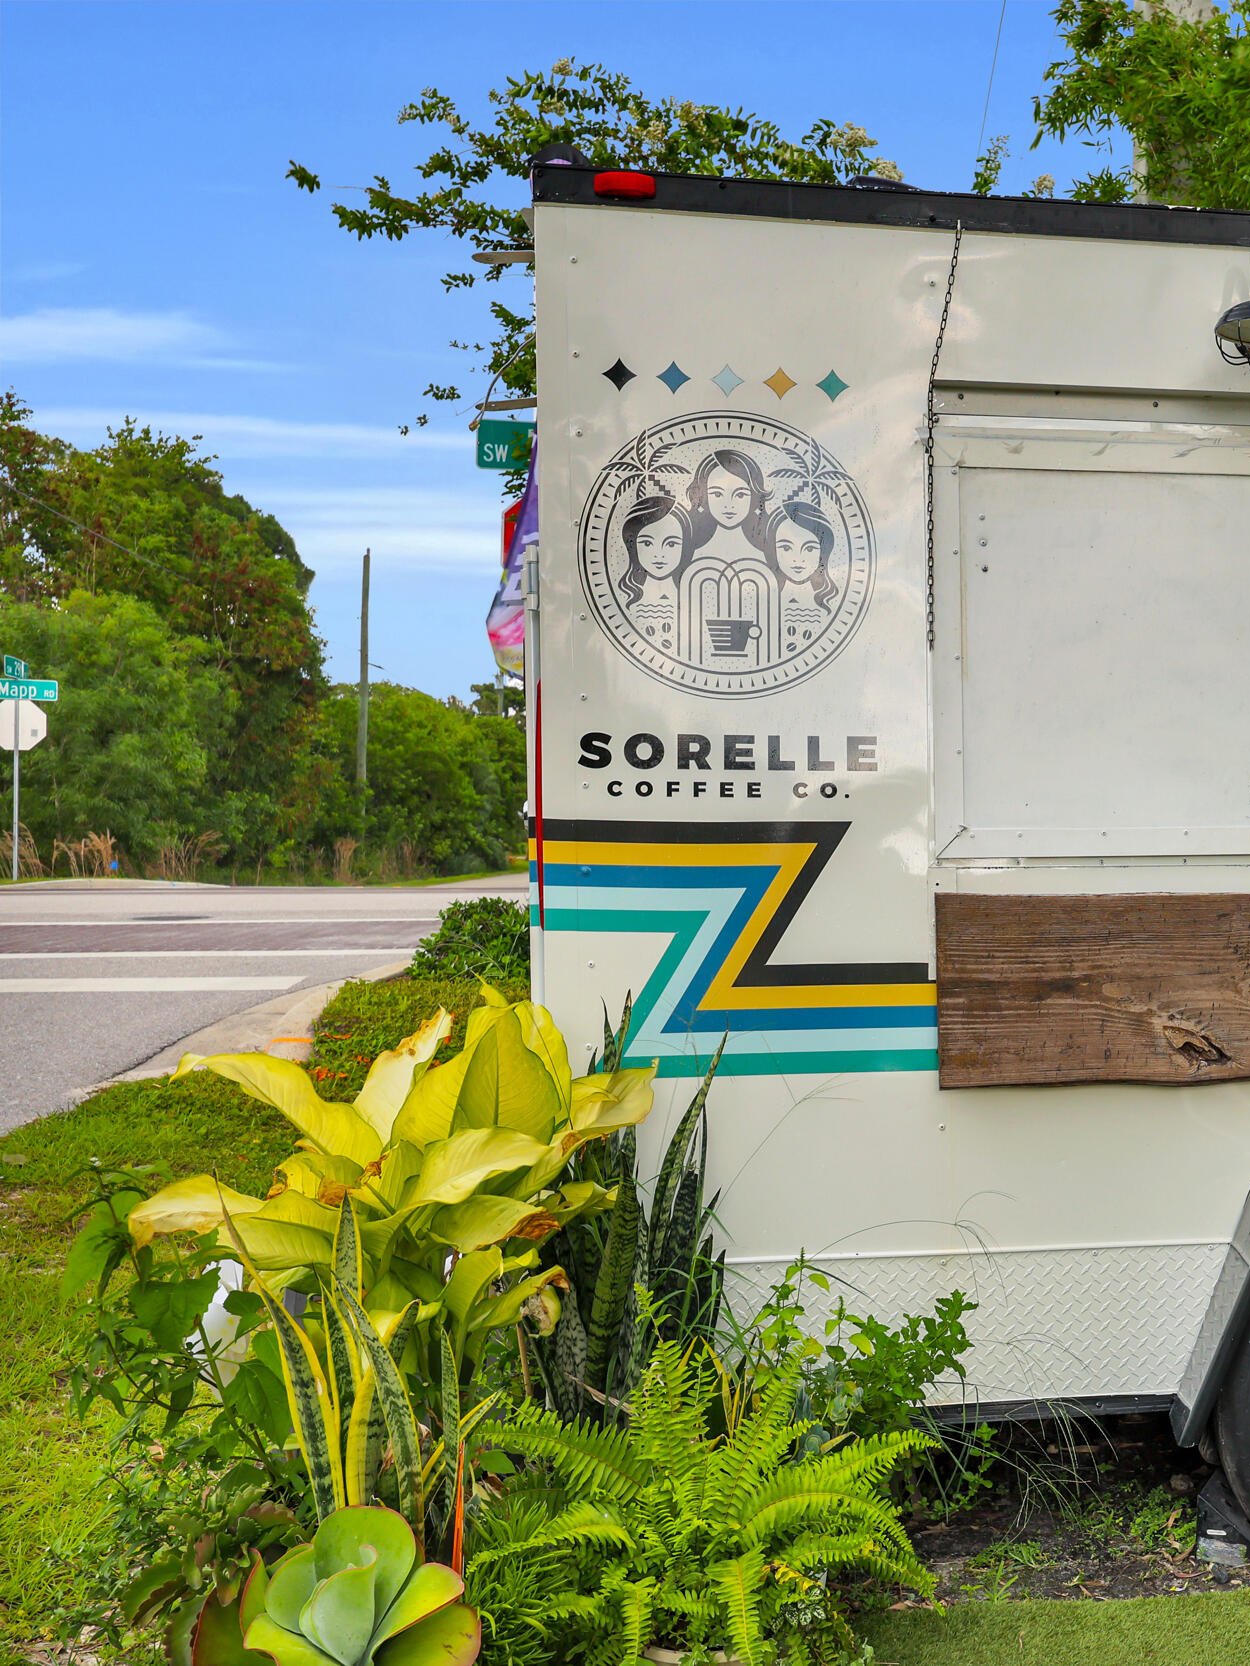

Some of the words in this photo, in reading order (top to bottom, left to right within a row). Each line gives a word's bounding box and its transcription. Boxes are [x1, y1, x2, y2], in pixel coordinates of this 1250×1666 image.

[483, 443, 508, 462] SW
[0, 682, 37, 699] Mapp
[44, 690, 55, 698] RD
[577, 731, 878, 772] SORELLE
[607, 780, 762, 798] COFFEE
[793, 782, 850, 799] CO.
